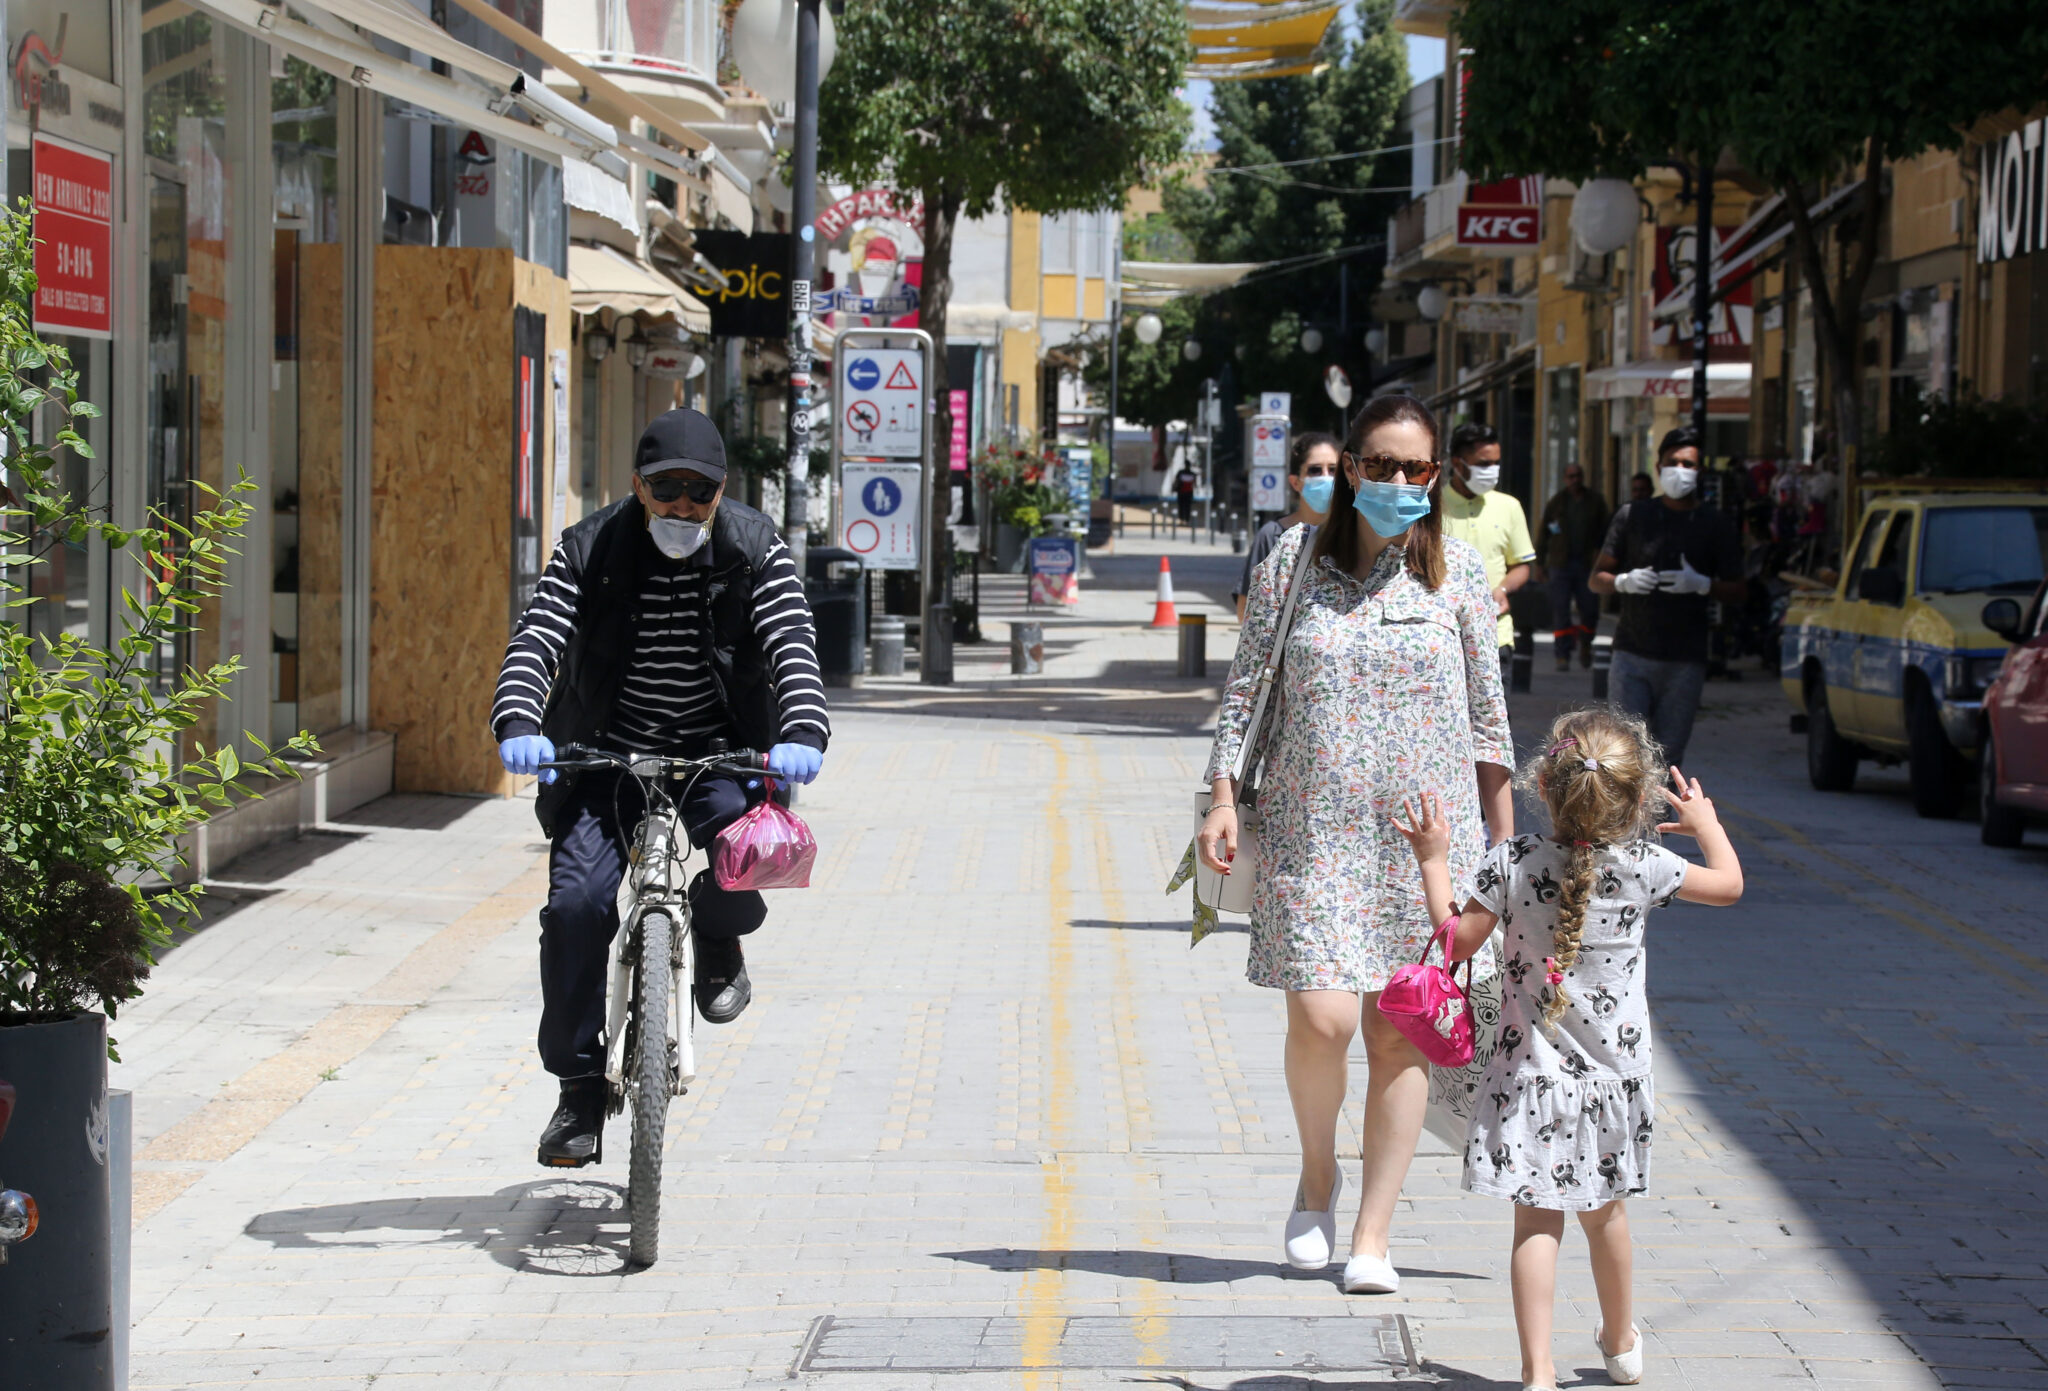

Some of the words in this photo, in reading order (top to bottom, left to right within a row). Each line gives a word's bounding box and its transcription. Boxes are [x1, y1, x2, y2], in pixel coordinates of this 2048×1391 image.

[36, 171, 54, 204] NEW
[56, 178, 91, 215] ARRIVALS
[1463, 216, 1533, 239] KFC
[57, 241, 94, 280] 50-80%
[40, 287, 55, 307] SALE
[55, 289, 64, 308] ON
[64, 290, 90, 312] SELECTED
[90, 293, 105, 315] ITEMS
[1642, 378, 1690, 396] KFC
